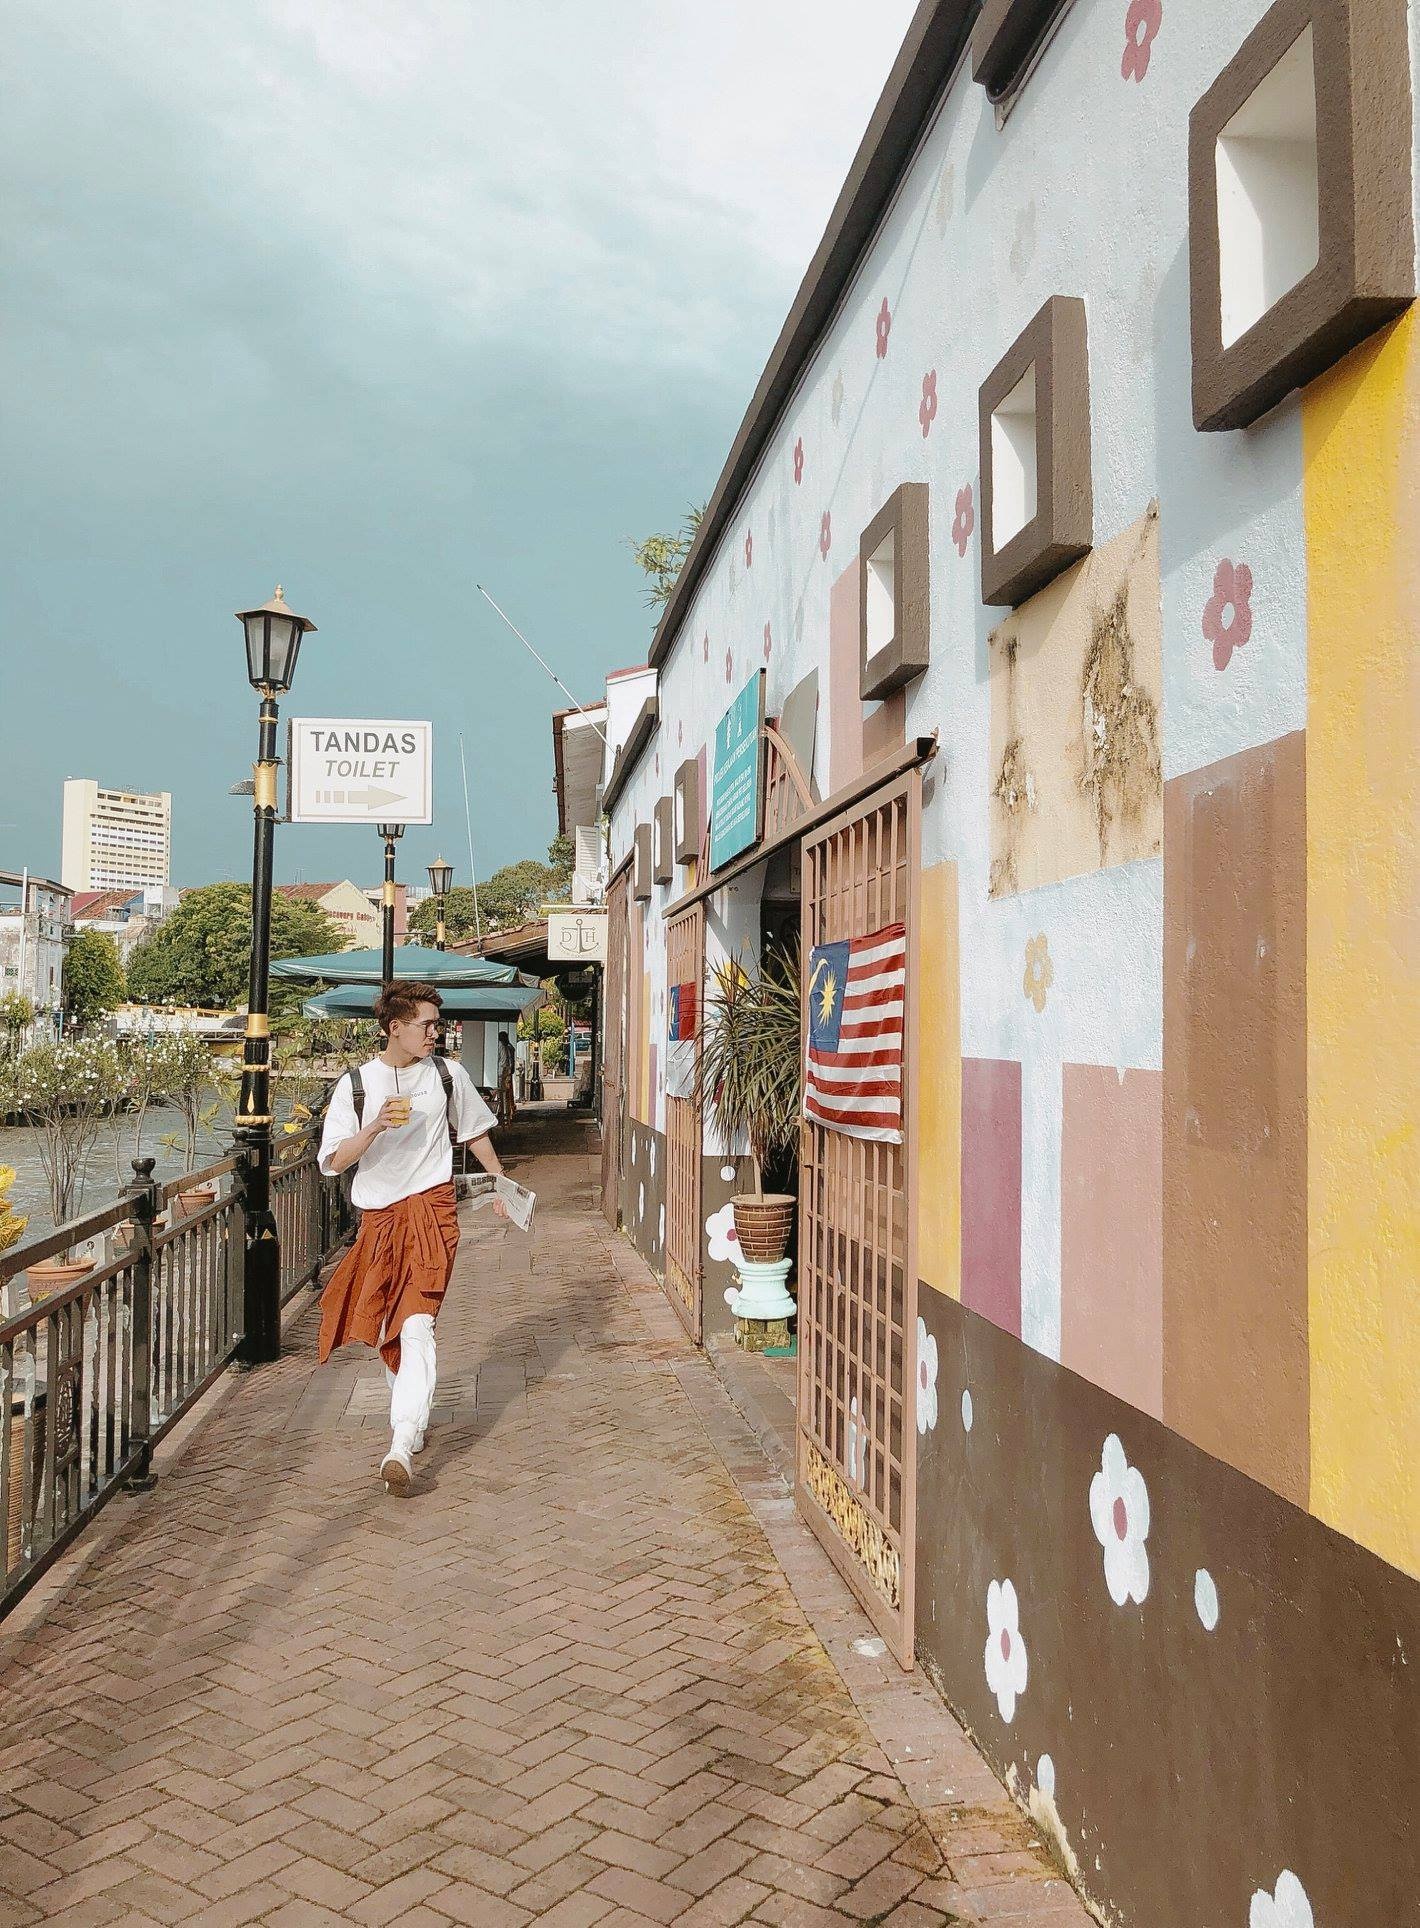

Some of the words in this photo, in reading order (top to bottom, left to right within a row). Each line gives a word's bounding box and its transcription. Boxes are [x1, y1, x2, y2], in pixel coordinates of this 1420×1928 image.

[310, 731, 416, 754] TANDAS
[325, 760, 400, 778] TOILET
[561, 931, 572, 943] D
[585, 931, 596, 943] H
